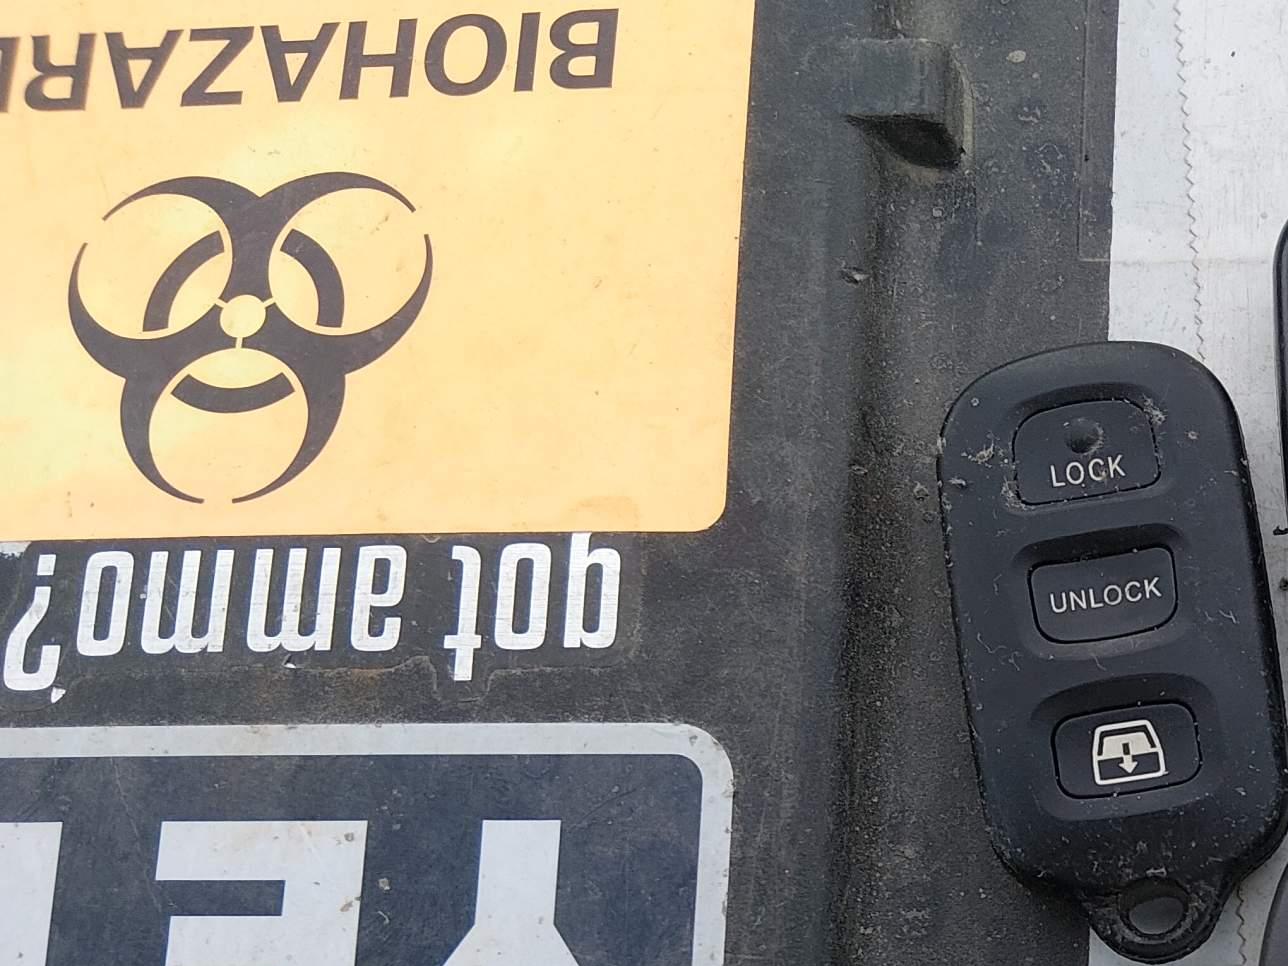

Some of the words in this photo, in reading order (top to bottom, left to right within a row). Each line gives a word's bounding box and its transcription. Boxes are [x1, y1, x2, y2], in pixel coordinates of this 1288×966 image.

[0, 8, 619, 113] BIOHAZAR
[1050, 454, 1126, 488] LOCK
[3, 545, 408, 691] ammo?
[444, 532, 621, 681] got
[1049, 576, 1162, 613] UNLOCK
